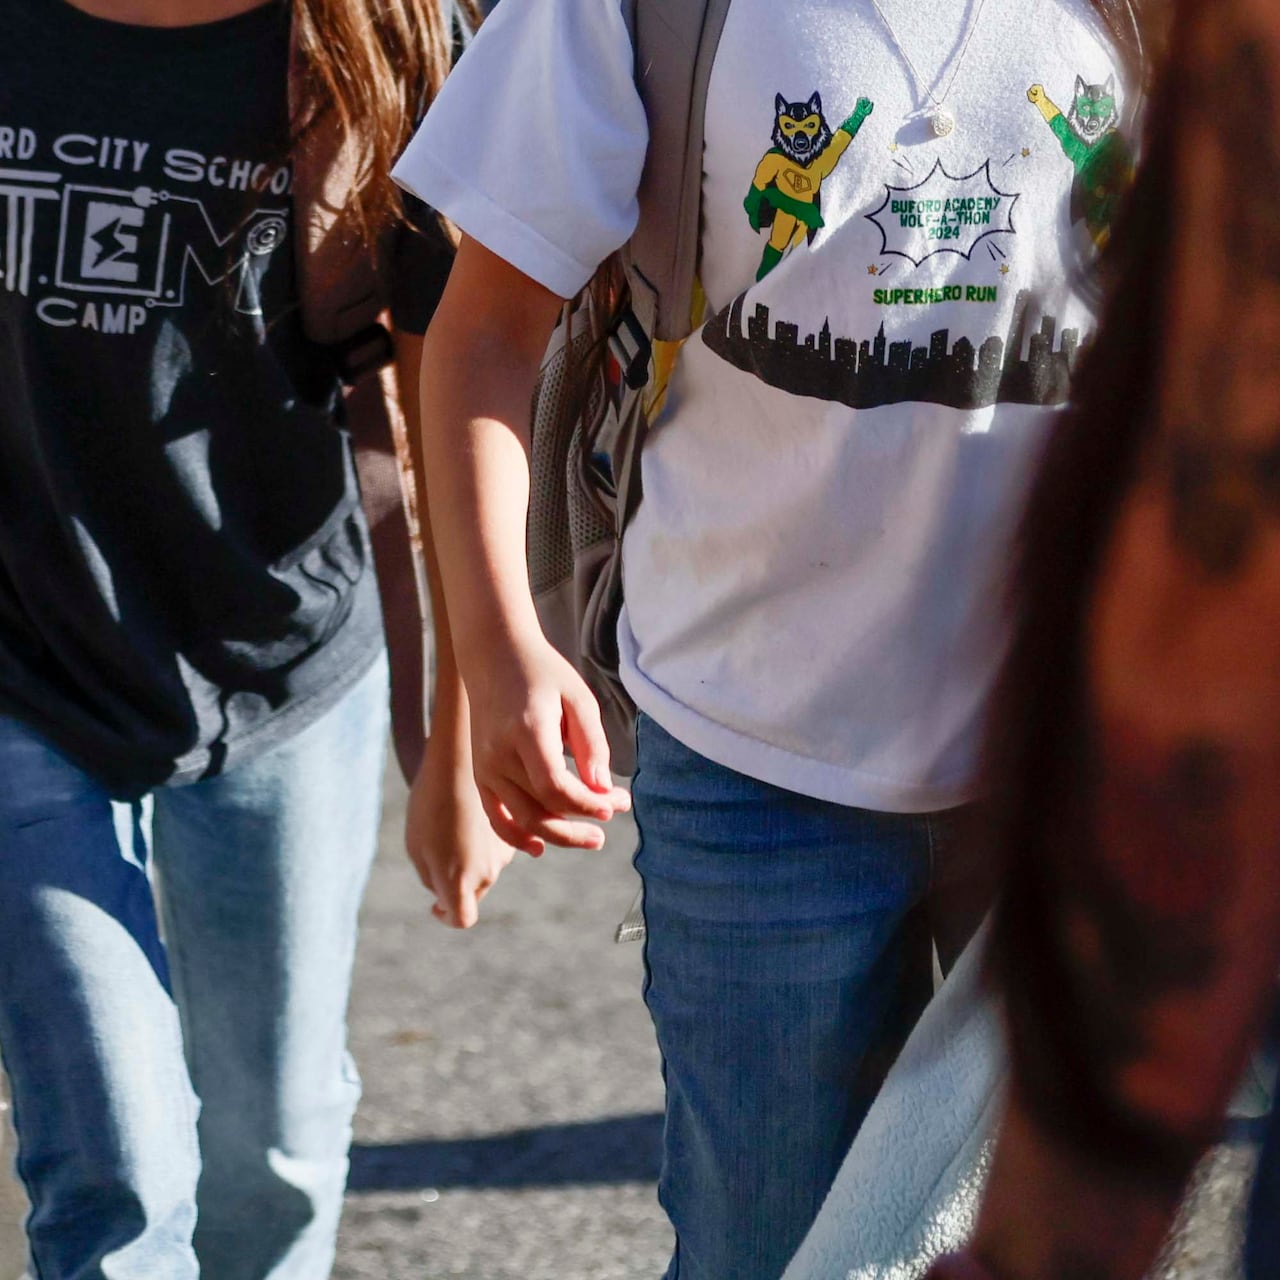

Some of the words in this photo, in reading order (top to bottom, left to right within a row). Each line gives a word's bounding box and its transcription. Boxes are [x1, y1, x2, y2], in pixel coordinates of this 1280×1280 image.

[52, 133, 150, 173] CITY
[162, 148, 295, 195] SCHOO
[891, 199, 941, 213] BUFORD
[944, 197, 1001, 212] ACADEMY
[900, 211, 990, 228] WOLF-A-THON
[928, 225, 960, 240] 2024
[872, 285, 962, 305] SUPERHERO
[965, 285, 997, 302] RUN
[35, 297, 147, 335] CAMP
